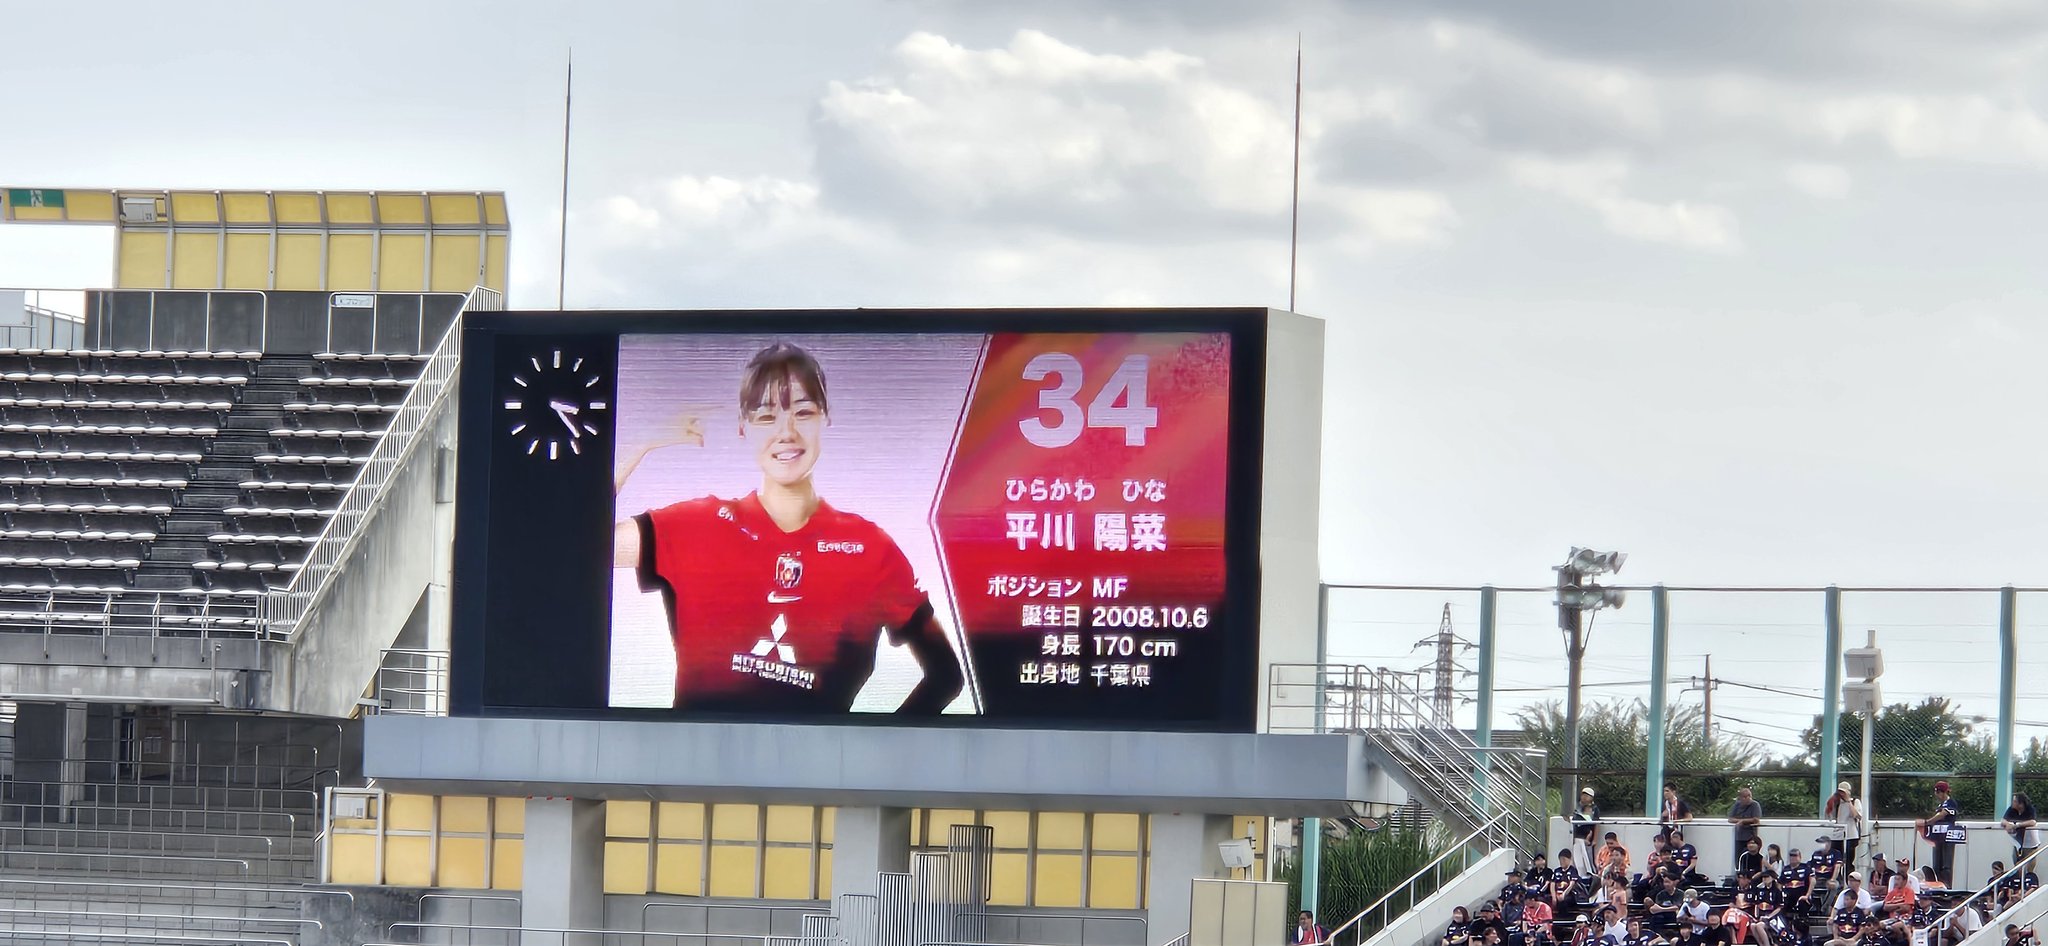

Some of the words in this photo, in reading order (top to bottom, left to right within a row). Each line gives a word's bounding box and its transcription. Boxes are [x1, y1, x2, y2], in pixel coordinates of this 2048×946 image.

[1018, 352, 1158, 448] 34
[1006, 479, 1096, 502] ひらかわ
[1122, 479, 1167, 501] ひな
[1005, 513, 1076, 551] 平川
[1094, 513, 1167, 552] 陽菜
[987, 576, 1082, 597] ポジション
[1092, 577, 1129, 598] MF
[1022, 605, 1081, 628] 誕生日
[1091, 607, 1209, 629] 2008.10.6
[1041, 635, 1081, 657] 身長
[1092, 636, 1135, 657] 170
[1141, 640, 1177, 656] cm
[1020, 664, 1080, 685] 出身地
[1090, 664, 1151, 686] 千葉県
